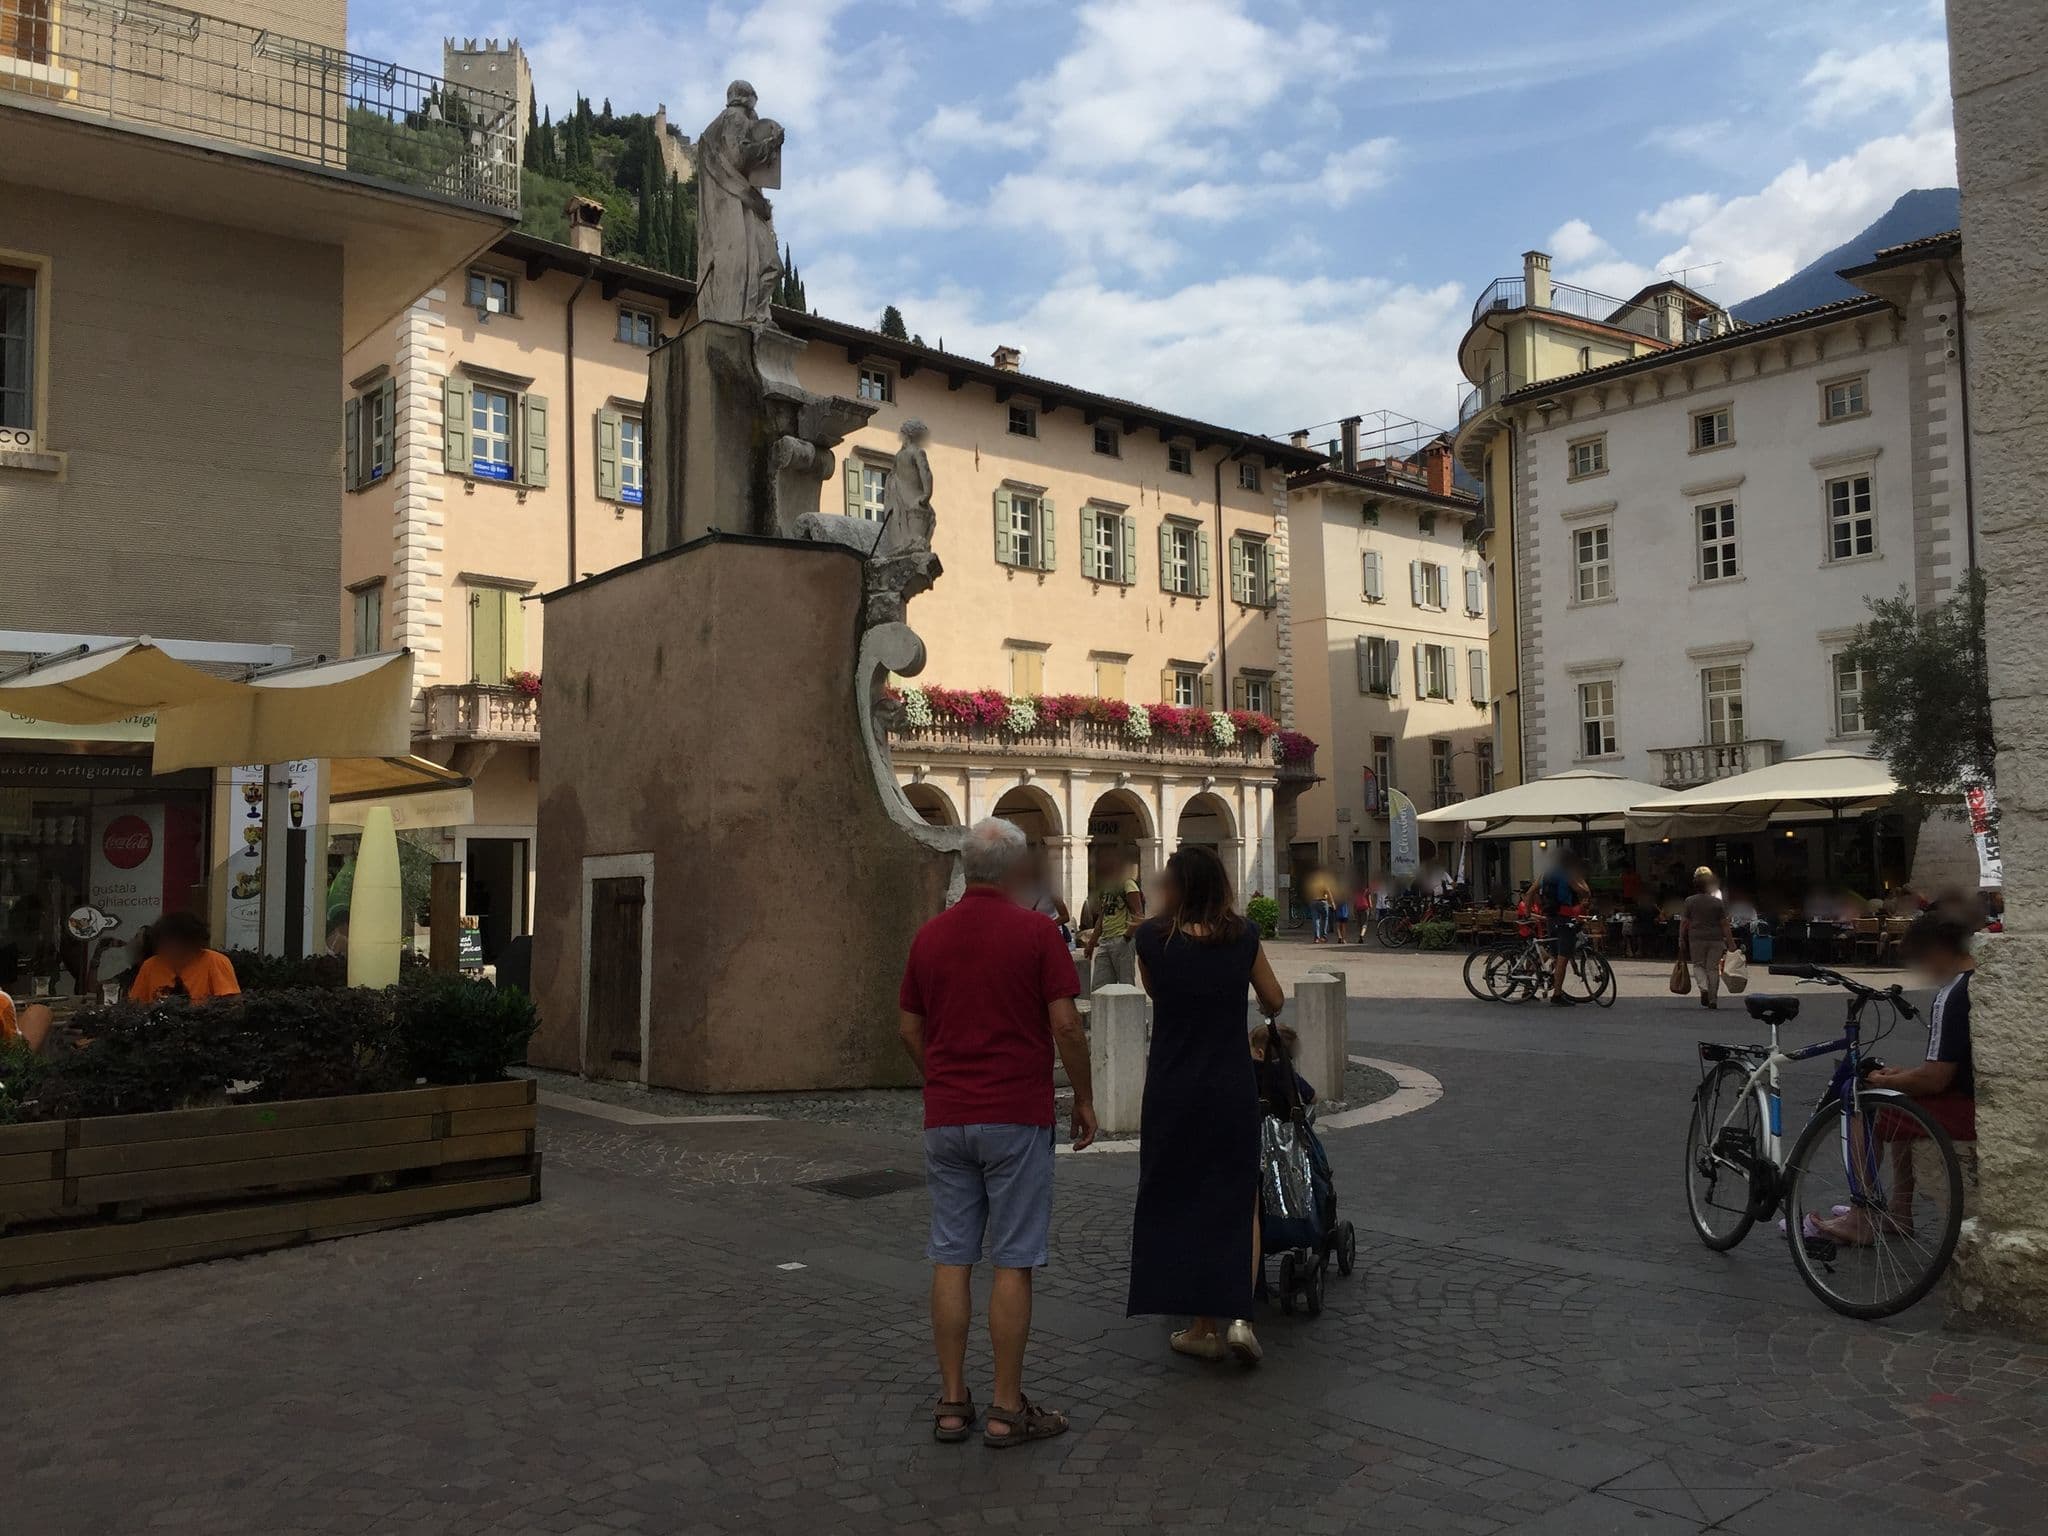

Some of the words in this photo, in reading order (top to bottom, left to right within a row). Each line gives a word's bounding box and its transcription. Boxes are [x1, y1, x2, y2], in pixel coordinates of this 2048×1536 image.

[55, 764, 145, 779] Artigianale
[92, 883, 137, 896] gustala
[97, 896, 161, 910] ghiacciata
